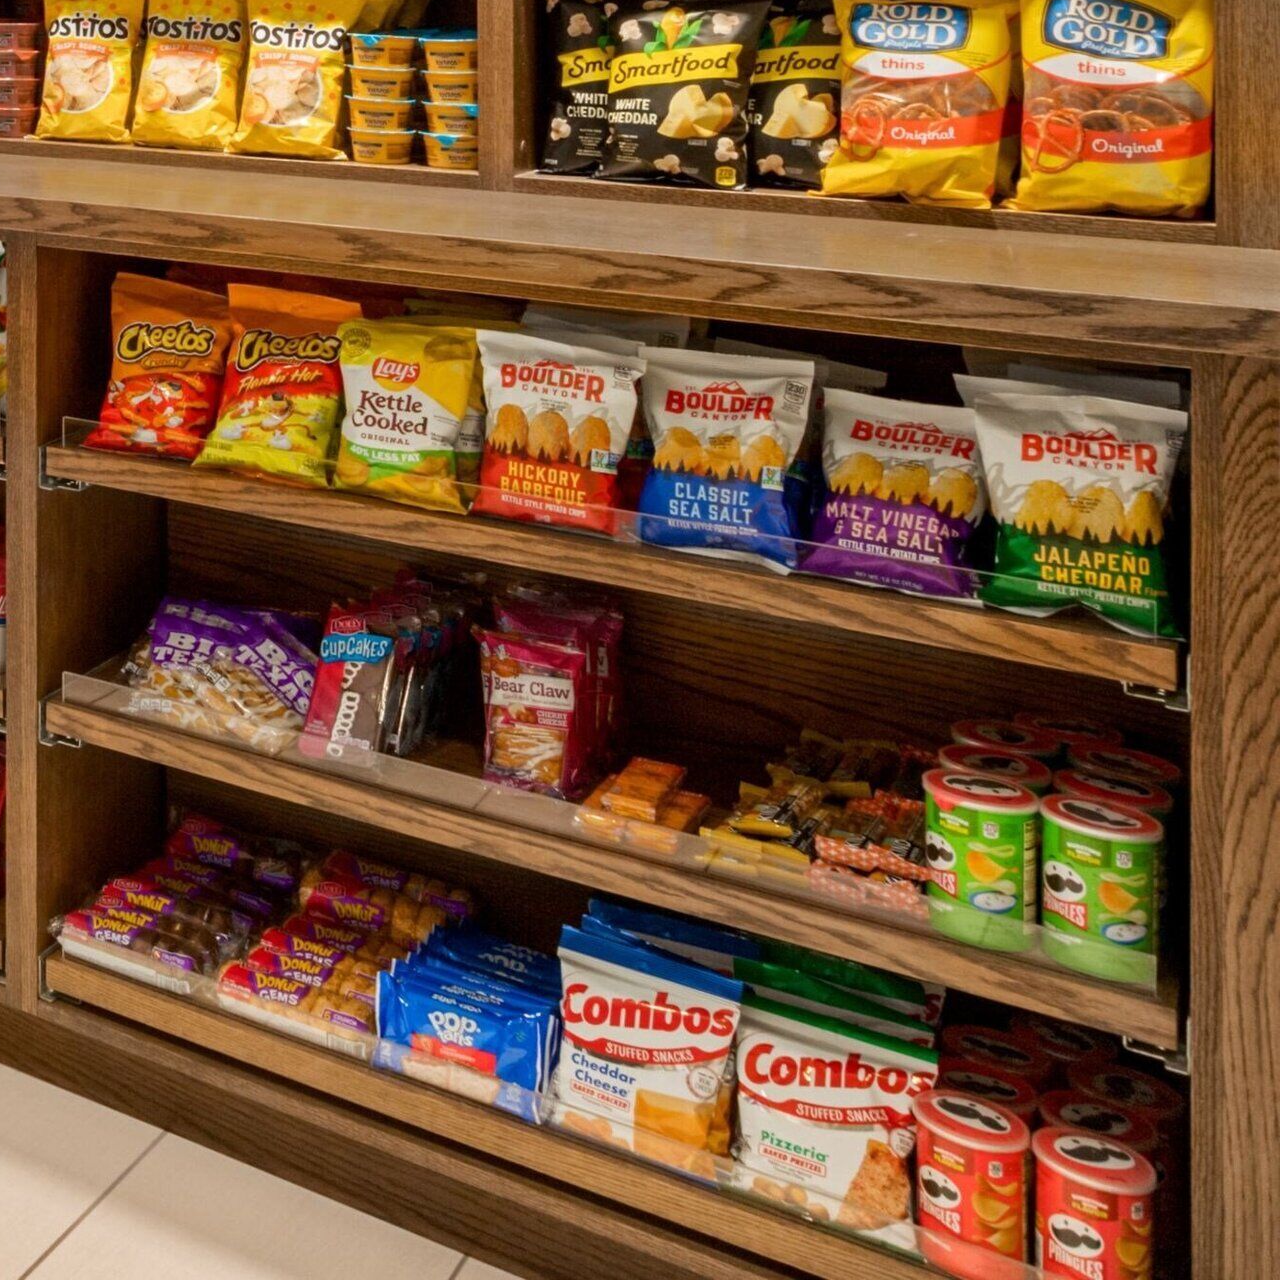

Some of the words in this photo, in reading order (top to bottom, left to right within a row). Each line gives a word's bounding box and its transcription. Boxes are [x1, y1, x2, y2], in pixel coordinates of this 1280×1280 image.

[870, 3, 954, 21] ROLD
[49, 13, 128, 39] OSTITOS
[857, 21, 957, 46] GOLD
[1052, 17, 1157, 55] GOLD
[614, 52, 731, 84] Smartfood
[753, 51, 839, 75] artfood
[881, 58, 925, 71] thins
[1078, 62, 1126, 76] thins
[615, 98, 650, 111] WHITE
[608, 110, 657, 125] CHEDDAR
[891, 127, 955, 144] Original
[1092, 138, 1164, 158] Original
[117, 321, 215, 362] Cheetos
[237, 331, 341, 371] Cheetos
[290, 368, 322, 384] Hot
[375, 358, 419, 384] Lay's
[501, 362, 605, 403] BOULDER
[359, 390, 423, 414] Kettle
[522, 384, 578, 399] CANYON
[665, 389, 774, 421] BOULDER
[691, 411, 747, 421] CANYON
[352, 410, 428, 437] Cooked
[361, 432, 410, 446] ORIGINAL
[851, 419, 976, 461] BOULDER
[877, 440, 941, 455] CANYON
[372, 449, 399, 462] LESS
[400, 452, 420, 463] FAT
[1021, 433, 1158, 476] BOULDER
[1052, 457, 1125, 472] CANYON
[508, 461, 581, 488] HICKORY
[500, 476, 586, 506] BARBEQUE
[675, 483, 750, 506] CLASSIC
[669, 500, 701, 519] SEA
[708, 504, 753, 525] SALT
[826, 502, 873, 521] MALT
[851, 522, 887, 543] SEA
[838, 538, 863, 551] KETTLE
[866, 544, 888, 555] STYLE
[890, 548, 917, 561] POTATO
[1034, 545, 1150, 575] JALAPEÑO
[1041, 565, 1142, 594] CHEDDAR
[494, 675, 524, 694] Bear
[529, 680, 570, 700] Claw
[192, 837, 235, 856] DONUT
[333, 901, 380, 921] DONUT
[92, 916, 138, 932] DONUT
[95, 930, 131, 945] GEMS
[293, 937, 337, 957] DONUT
[256, 973, 306, 991] DONUT
[259, 989, 299, 1005] GEMS
[562, 982, 735, 1038] Combos
[605, 1041, 649, 1062] STUFFED
[652, 1049, 694, 1064] SNACKS
[572, 1052, 636, 1086] Cheddar
[744, 1042, 938, 1099] Combos
[575, 1069, 629, 1098] Cheese
[572, 1083, 594, 1096] BAKED
[595, 1089, 628, 1109] CRACKER
[796, 1103, 843, 1121] STUFFED
[847, 1107, 888, 1122] SNACKS
[760, 1130, 829, 1163] Pizzeria
[763, 1147, 788, 1161] BAKED
[789, 1156, 823, 1175] PRETZEL
[1048, 1238, 1103, 1280] PRINGLES
